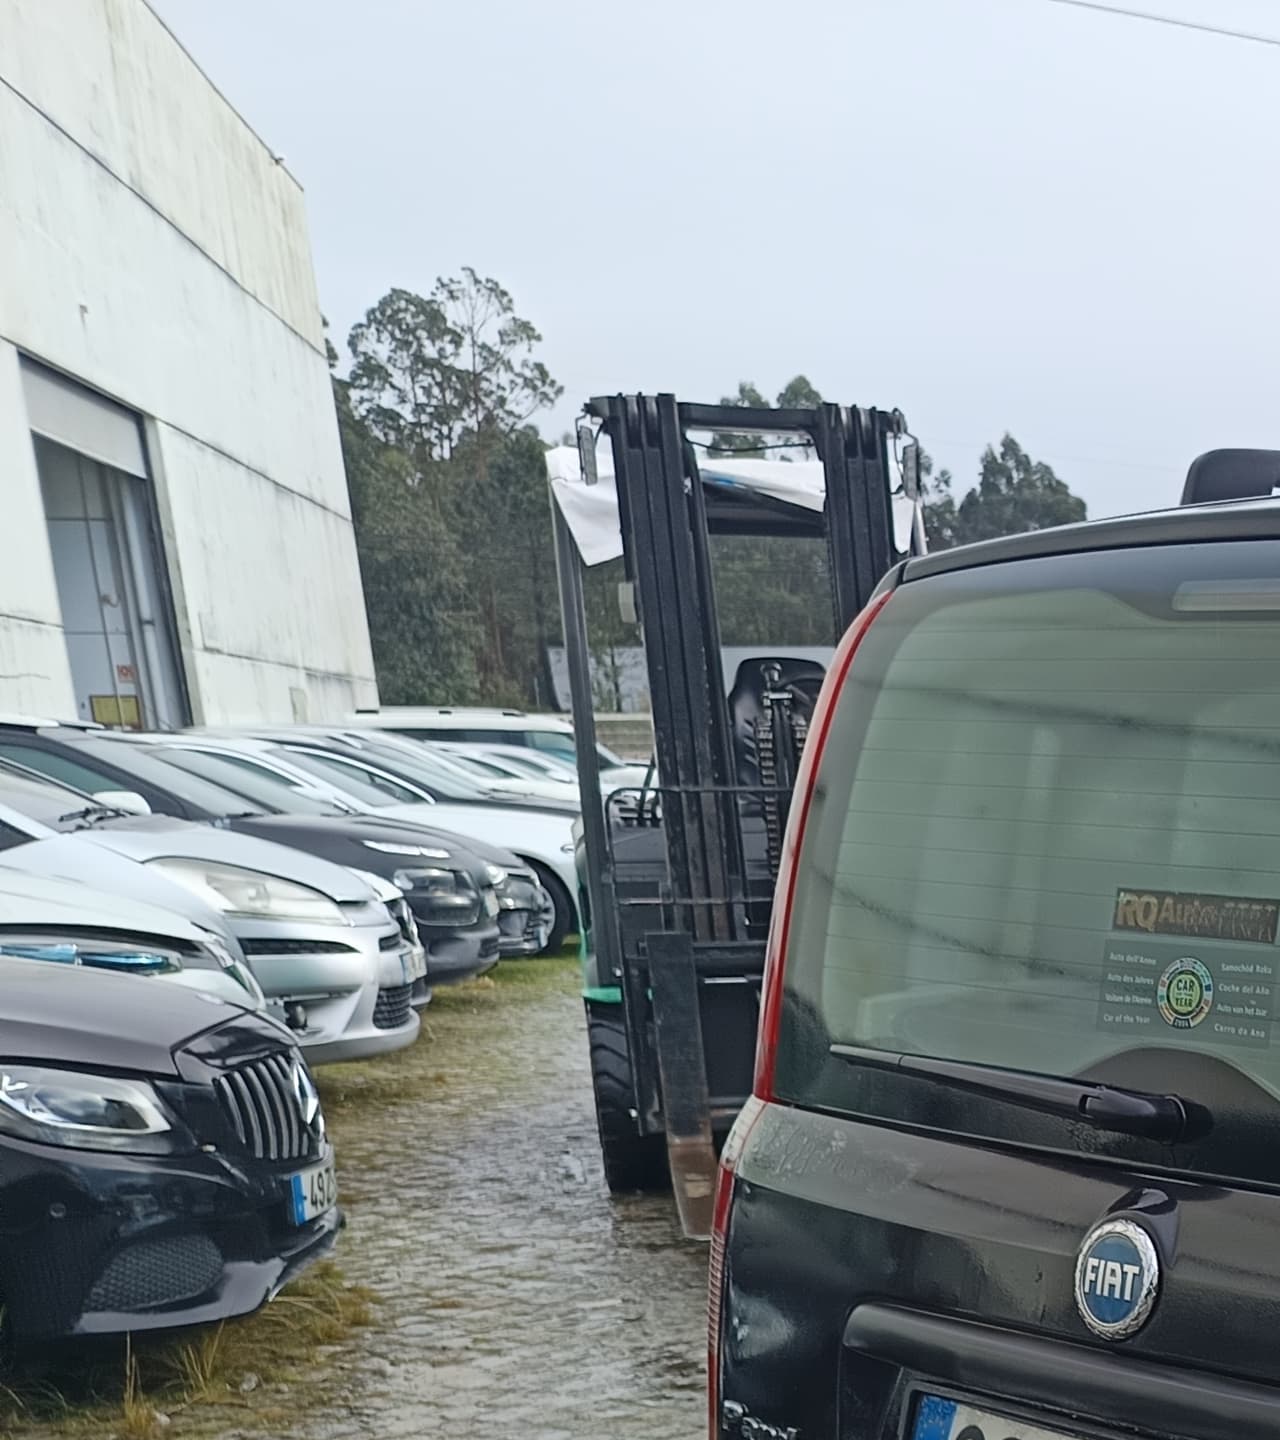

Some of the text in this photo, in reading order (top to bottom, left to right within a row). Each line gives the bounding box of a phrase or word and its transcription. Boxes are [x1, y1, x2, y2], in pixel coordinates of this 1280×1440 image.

[1177, 979, 1195, 993] CAR
[1175, 997, 1193, 1008] YEAR
[1084, 1257, 1140, 1301] FIAT
